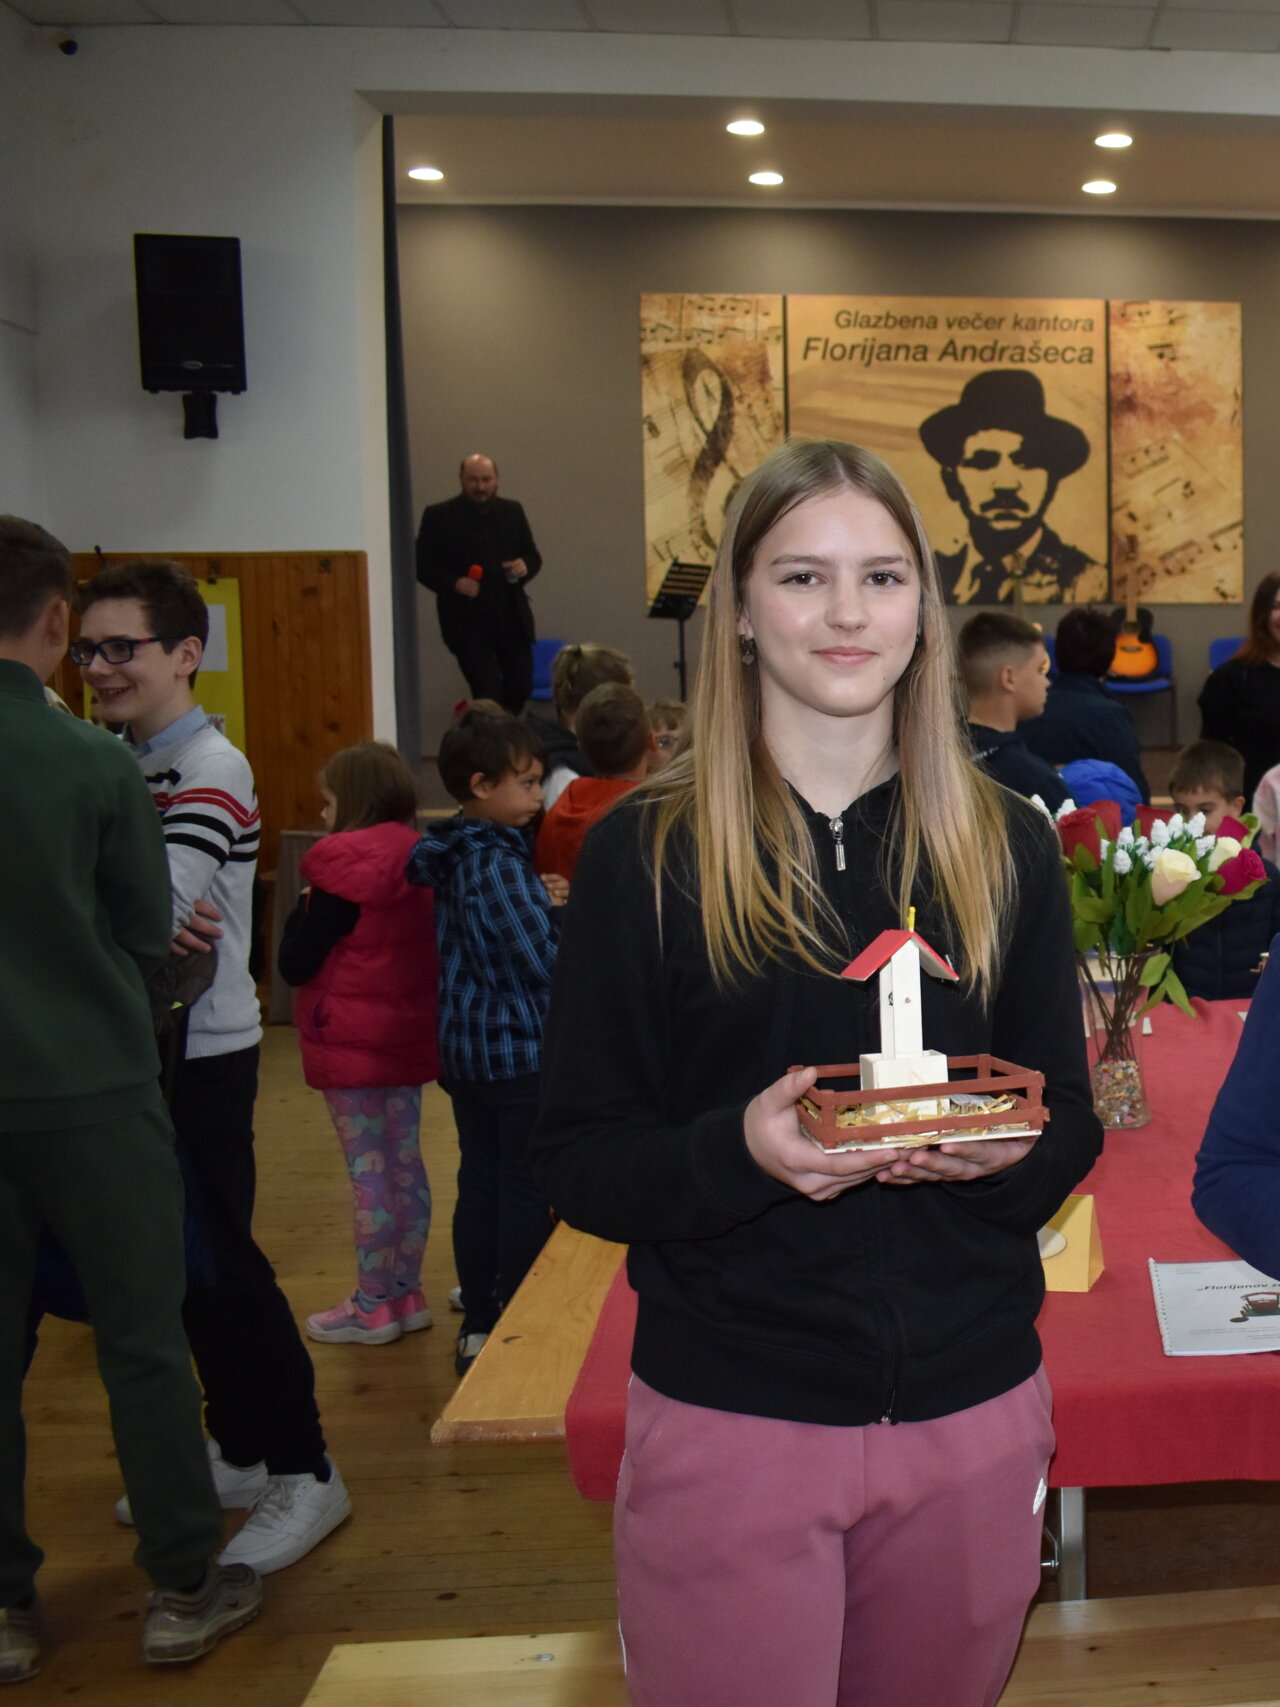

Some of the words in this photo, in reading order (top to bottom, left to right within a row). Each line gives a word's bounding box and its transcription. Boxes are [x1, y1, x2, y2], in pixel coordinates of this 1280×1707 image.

[834, 309, 939, 330] Glazbena
[946, 311, 1008, 331] večer
[1012, 312, 1095, 332] kantora
[802, 336, 929, 368] Florijana
[937, 338, 1095, 364] Andrašeca
